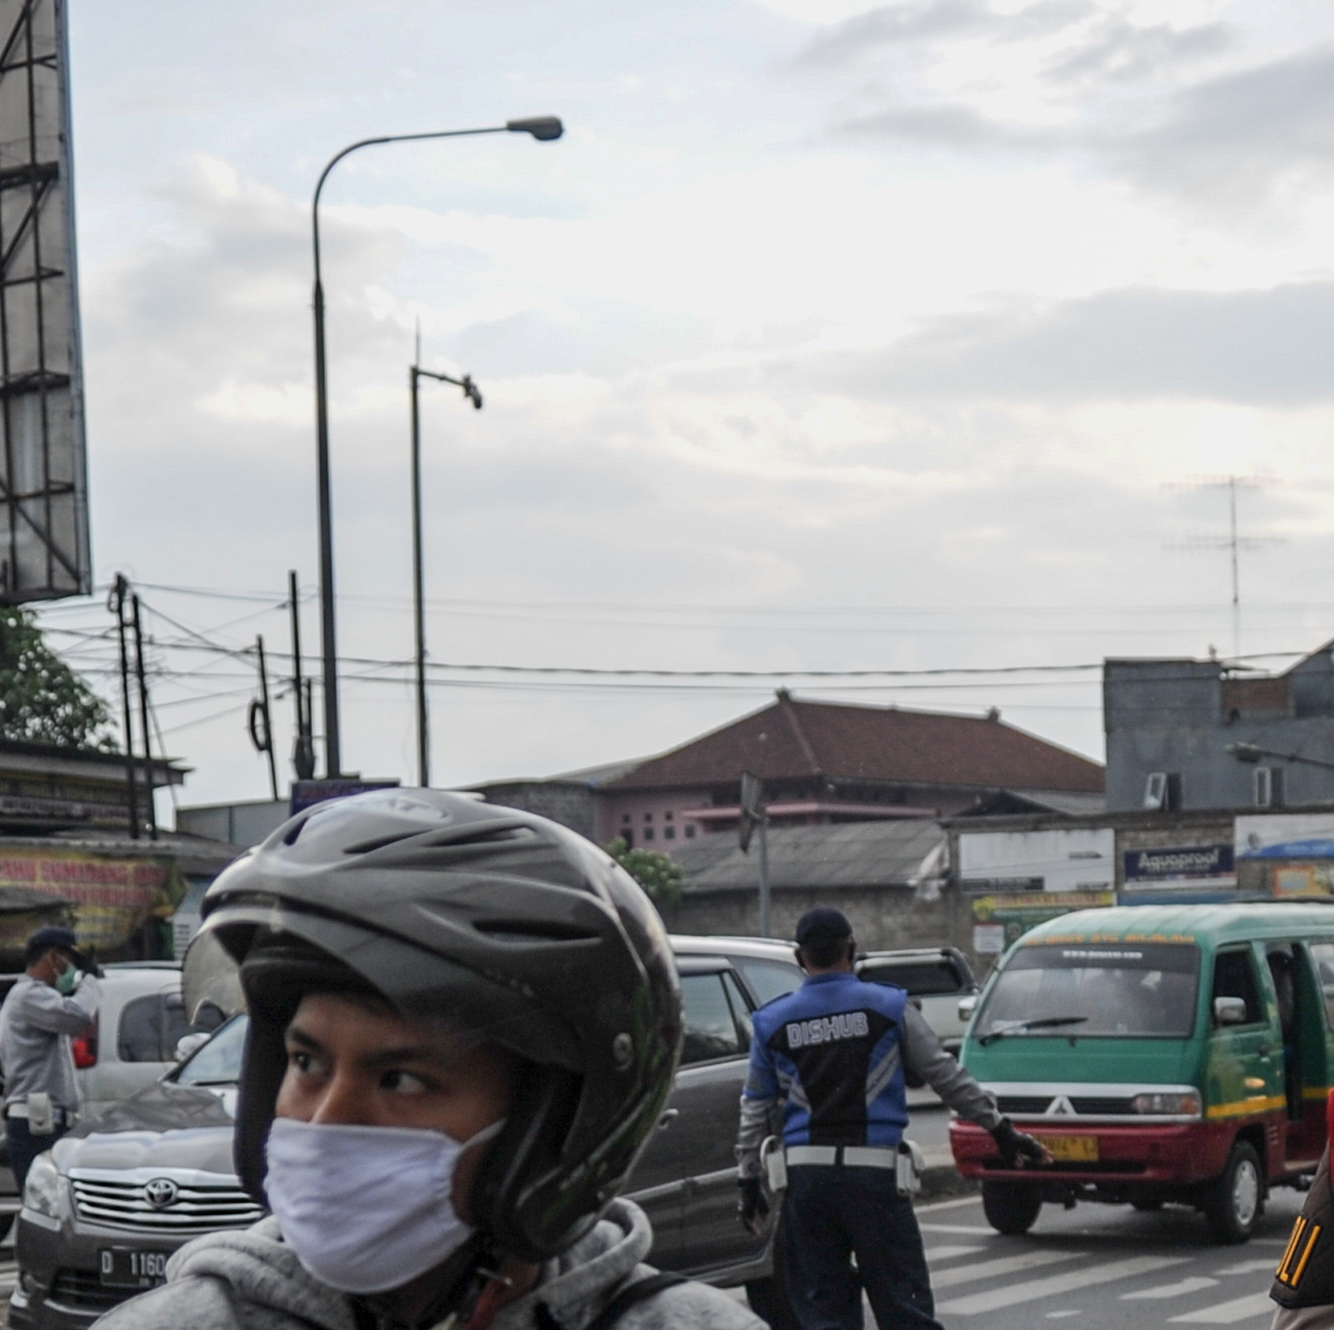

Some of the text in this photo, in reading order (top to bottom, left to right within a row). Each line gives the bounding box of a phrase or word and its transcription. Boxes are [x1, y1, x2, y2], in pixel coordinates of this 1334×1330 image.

[786, 1011, 870, 1050] DISHUB
[102, 1251, 113, 1274] D
[1276, 1215, 1322, 1287] LI
